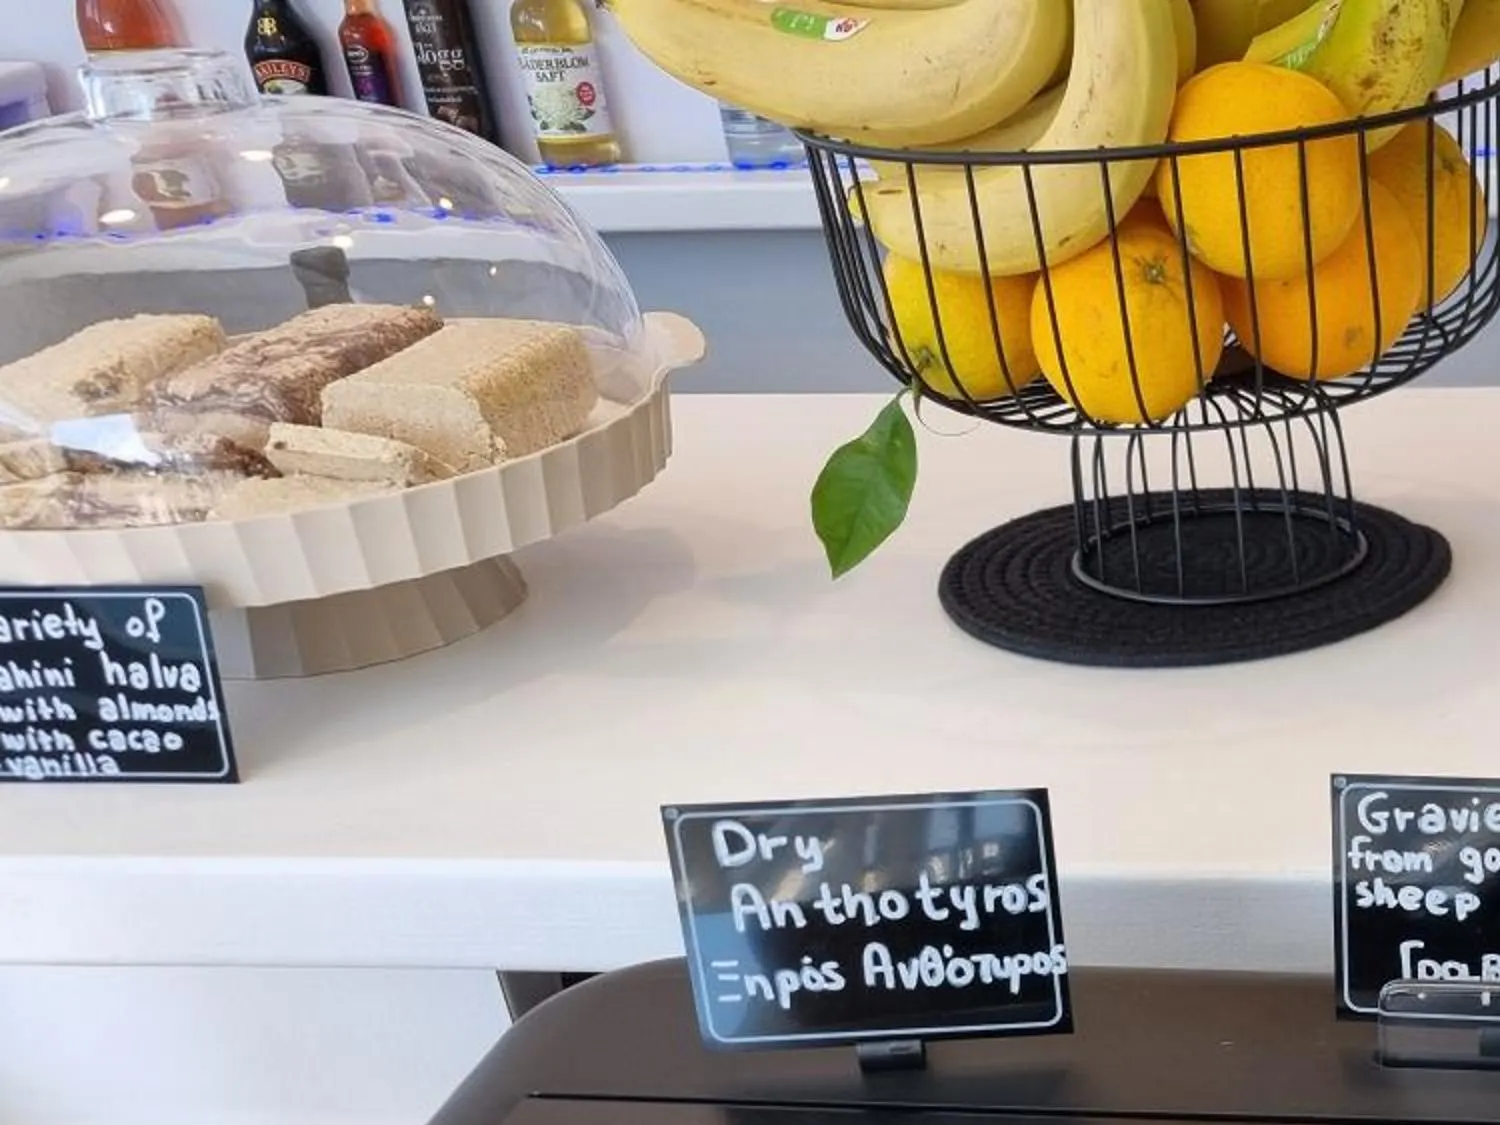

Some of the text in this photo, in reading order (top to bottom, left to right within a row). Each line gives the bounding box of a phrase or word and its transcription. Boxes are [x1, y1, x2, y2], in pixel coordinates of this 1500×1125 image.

[0, 598, 165, 650] ariety of
[0, 650, 201, 692] ahini halva
[1, 726, 183, 752] with cacao
[711, 819, 825, 873] Dry
[1347, 836, 1433, 873] from
[730, 871, 1048, 933] Anthotyros
[1355, 877, 1481, 921] sheep
